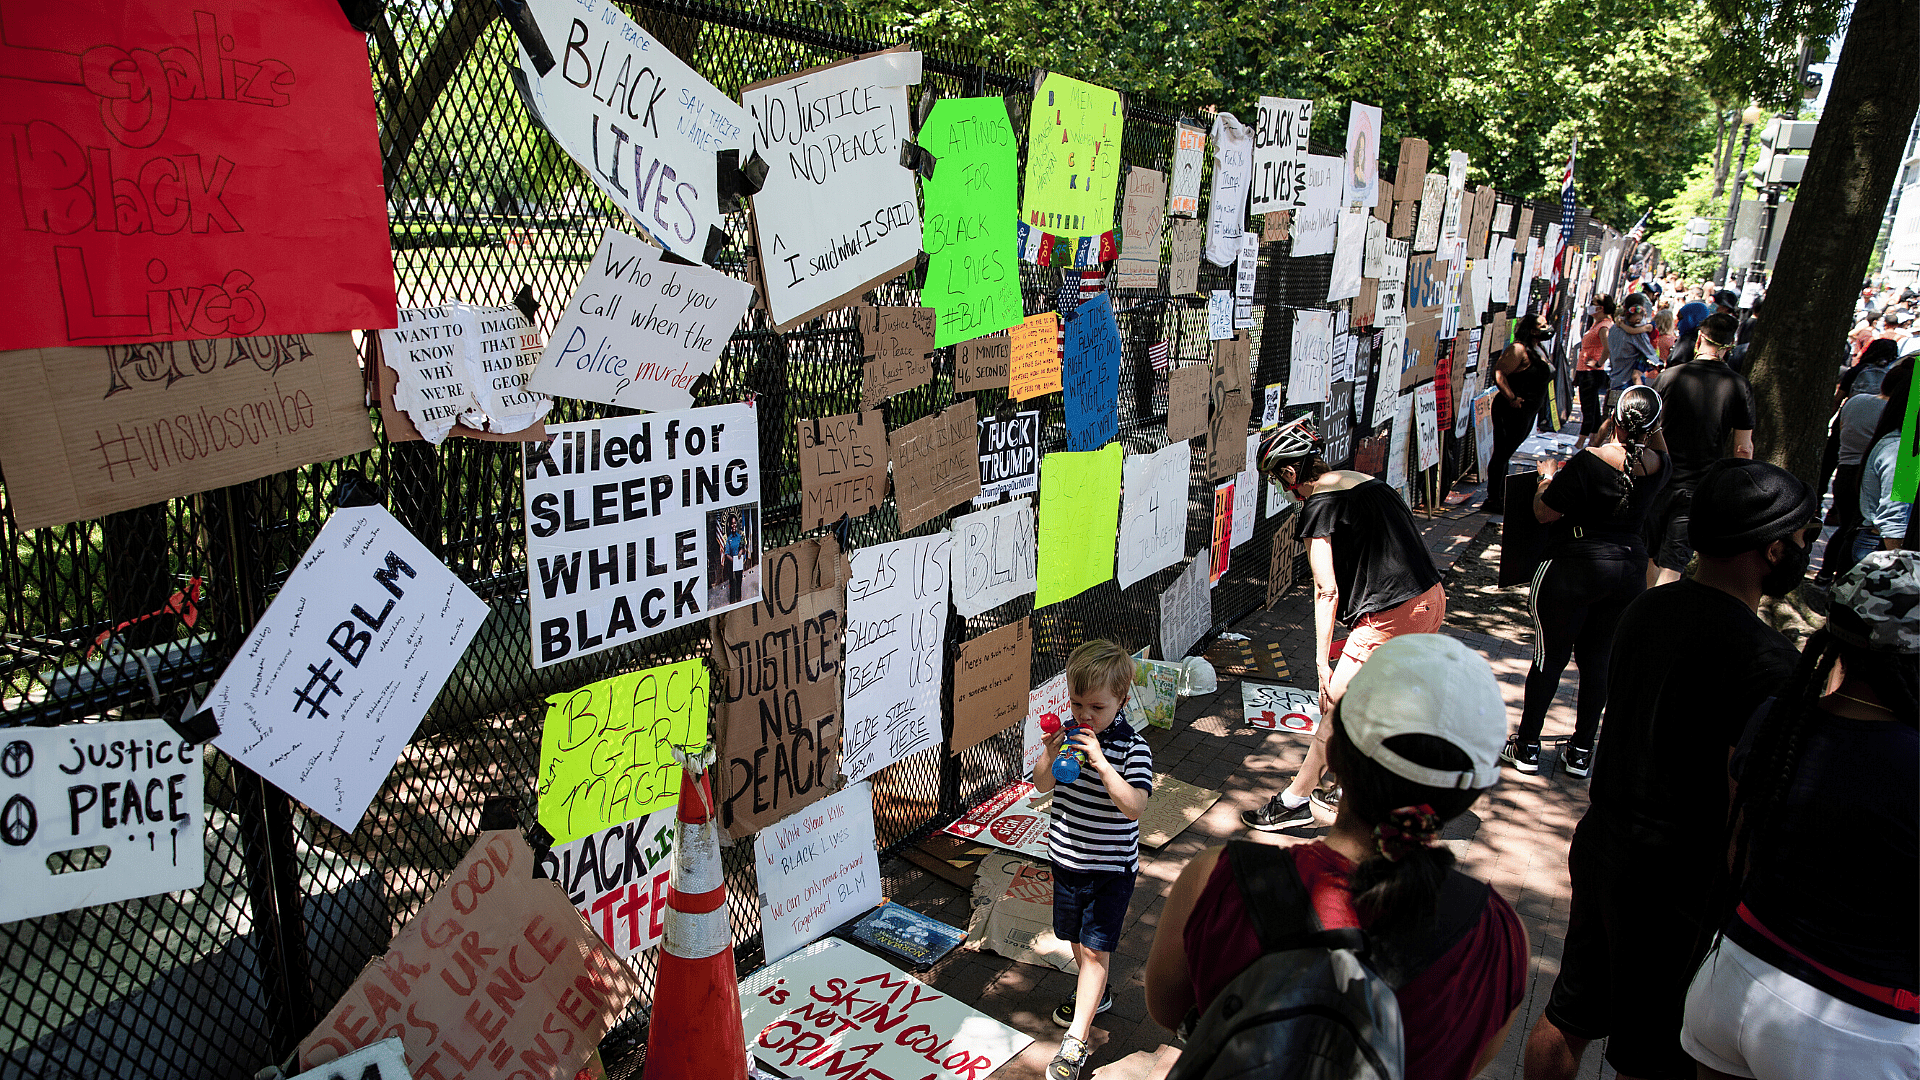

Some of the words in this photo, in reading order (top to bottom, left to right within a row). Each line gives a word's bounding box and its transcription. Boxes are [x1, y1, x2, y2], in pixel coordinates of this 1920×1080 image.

[620, 22, 650, 52] PEACE
[563, 18, 667, 139] BLACK
[678, 88, 706, 120] SAY
[711, 109, 741, 141] THEIR
[751, 94, 786, 149] NO
[787, 82, 881, 146] JUSTICE
[1255, 106, 1294, 149] BLACK
[1180, 130, 1197, 150] GET
[1293, 102, 1311, 207] MATTER
[593, 113, 698, 244] LIVES
[789, 143, 827, 185] NO
[962, 162, 992, 197] FOR
[1129, 171, 1155, 195] Defund
[1252, 160, 1293, 204] LIVES
[1308, 168, 1325, 188] BUILD
[784, 253, 805, 288] I
[808, 238, 841, 277] said
[860, 220, 877, 248] I
[874, 201, 915, 237] SAID
[929, 213, 990, 255] BLACK
[54, 246, 267, 341] Lives
[604, 242, 652, 288] Who
[661, 271, 681, 297] do
[679, 289, 717, 314] you
[1176, 267, 1196, 290] BLM
[395, 326, 439, 344] WANT
[443, 323, 463, 338] TO
[399, 310, 414, 323] IF
[418, 306, 450, 321] YOU
[579, 293, 622, 320] Call
[630, 303, 680, 338] when
[683, 321, 713, 352] the
[880, 314, 910, 336] Justice
[942, 295, 996, 335] #BLM
[409, 344, 455, 362] KNOW
[480, 337, 516, 354] THAT
[520, 333, 543, 349] YOU
[555, 325, 627, 377] Police
[874, 340, 889, 358] No
[892, 335, 915, 358] Peace
[962, 346, 969, 364] 8
[975, 343, 1009, 361] MINUTES
[1067, 349, 1089, 378] RIGHT
[1092, 344, 1105, 363] TO
[1106, 335, 1117, 357] DO
[419, 364, 454, 381] WHY
[482, 358, 512, 373] HAD
[957, 366, 971, 385] 46
[975, 362, 1008, 379] SECONDS
[1068, 369, 1093, 400] WHAT
[420, 383, 465, 401] WE'RE
[1323, 388, 1350, 422] BLACK
[90, 381, 315, 482] #unsubscribe
[899, 436, 938, 469] BLACK
[937, 427, 947, 449] IS
[951, 415, 975, 445] NOT
[989, 417, 1031, 453] FUCK
[1327, 415, 1349, 440] LIVES
[526, 421, 652, 481] Killed
[665, 419, 725, 460] for
[816, 444, 874, 477] LIVES
[979, 445, 1033, 483] TRUMP
[1321, 437, 1350, 465] ATTER
[908, 476, 919, 495] A
[930, 450, 970, 487] CRIME
[530, 458, 749, 539] SLEEPING
[808, 475, 874, 518] MATTER
[1149, 491, 1159, 536] 4
[537, 529, 699, 599] WHILE
[848, 548, 900, 600] GAS
[912, 538, 951, 600] US
[963, 506, 1034, 600] BLM
[752, 552, 799, 628] NO
[292, 549, 418, 720] #BLM
[540, 576, 701, 663] BLACK
[847, 613, 902, 655] SHOOT
[911, 601, 943, 652] US
[848, 648, 899, 700] BEAT
[909, 649, 936, 689] US
[557, 668, 708, 753] BLACK
[758, 688, 803, 745] NO
[885, 697, 917, 726] STILL
[59, 737, 196, 775] justice
[590, 706, 706, 777] GIRL
[890, 715, 928, 757] HERE
[722, 713, 836, 833] PEACE
[67, 773, 192, 836] PEACE
[560, 761, 681, 835] MAGI
[775, 824, 800, 851] White
[826, 803, 845, 823] Kills
[781, 842, 819, 875] BLACK
[420, 833, 514, 950] GOOD
[770, 902, 785, 921] We
[786, 894, 801, 913] can
[837, 870, 866, 903] BLM
[439, 929, 500, 997] UR
[757, 978, 791, 1006] is
[809, 977, 909, 1033] SKIN
[853, 972, 944, 1013] MY
[789, 1002, 863, 1037] NOT
[895, 1024, 992, 1080] COLOR
